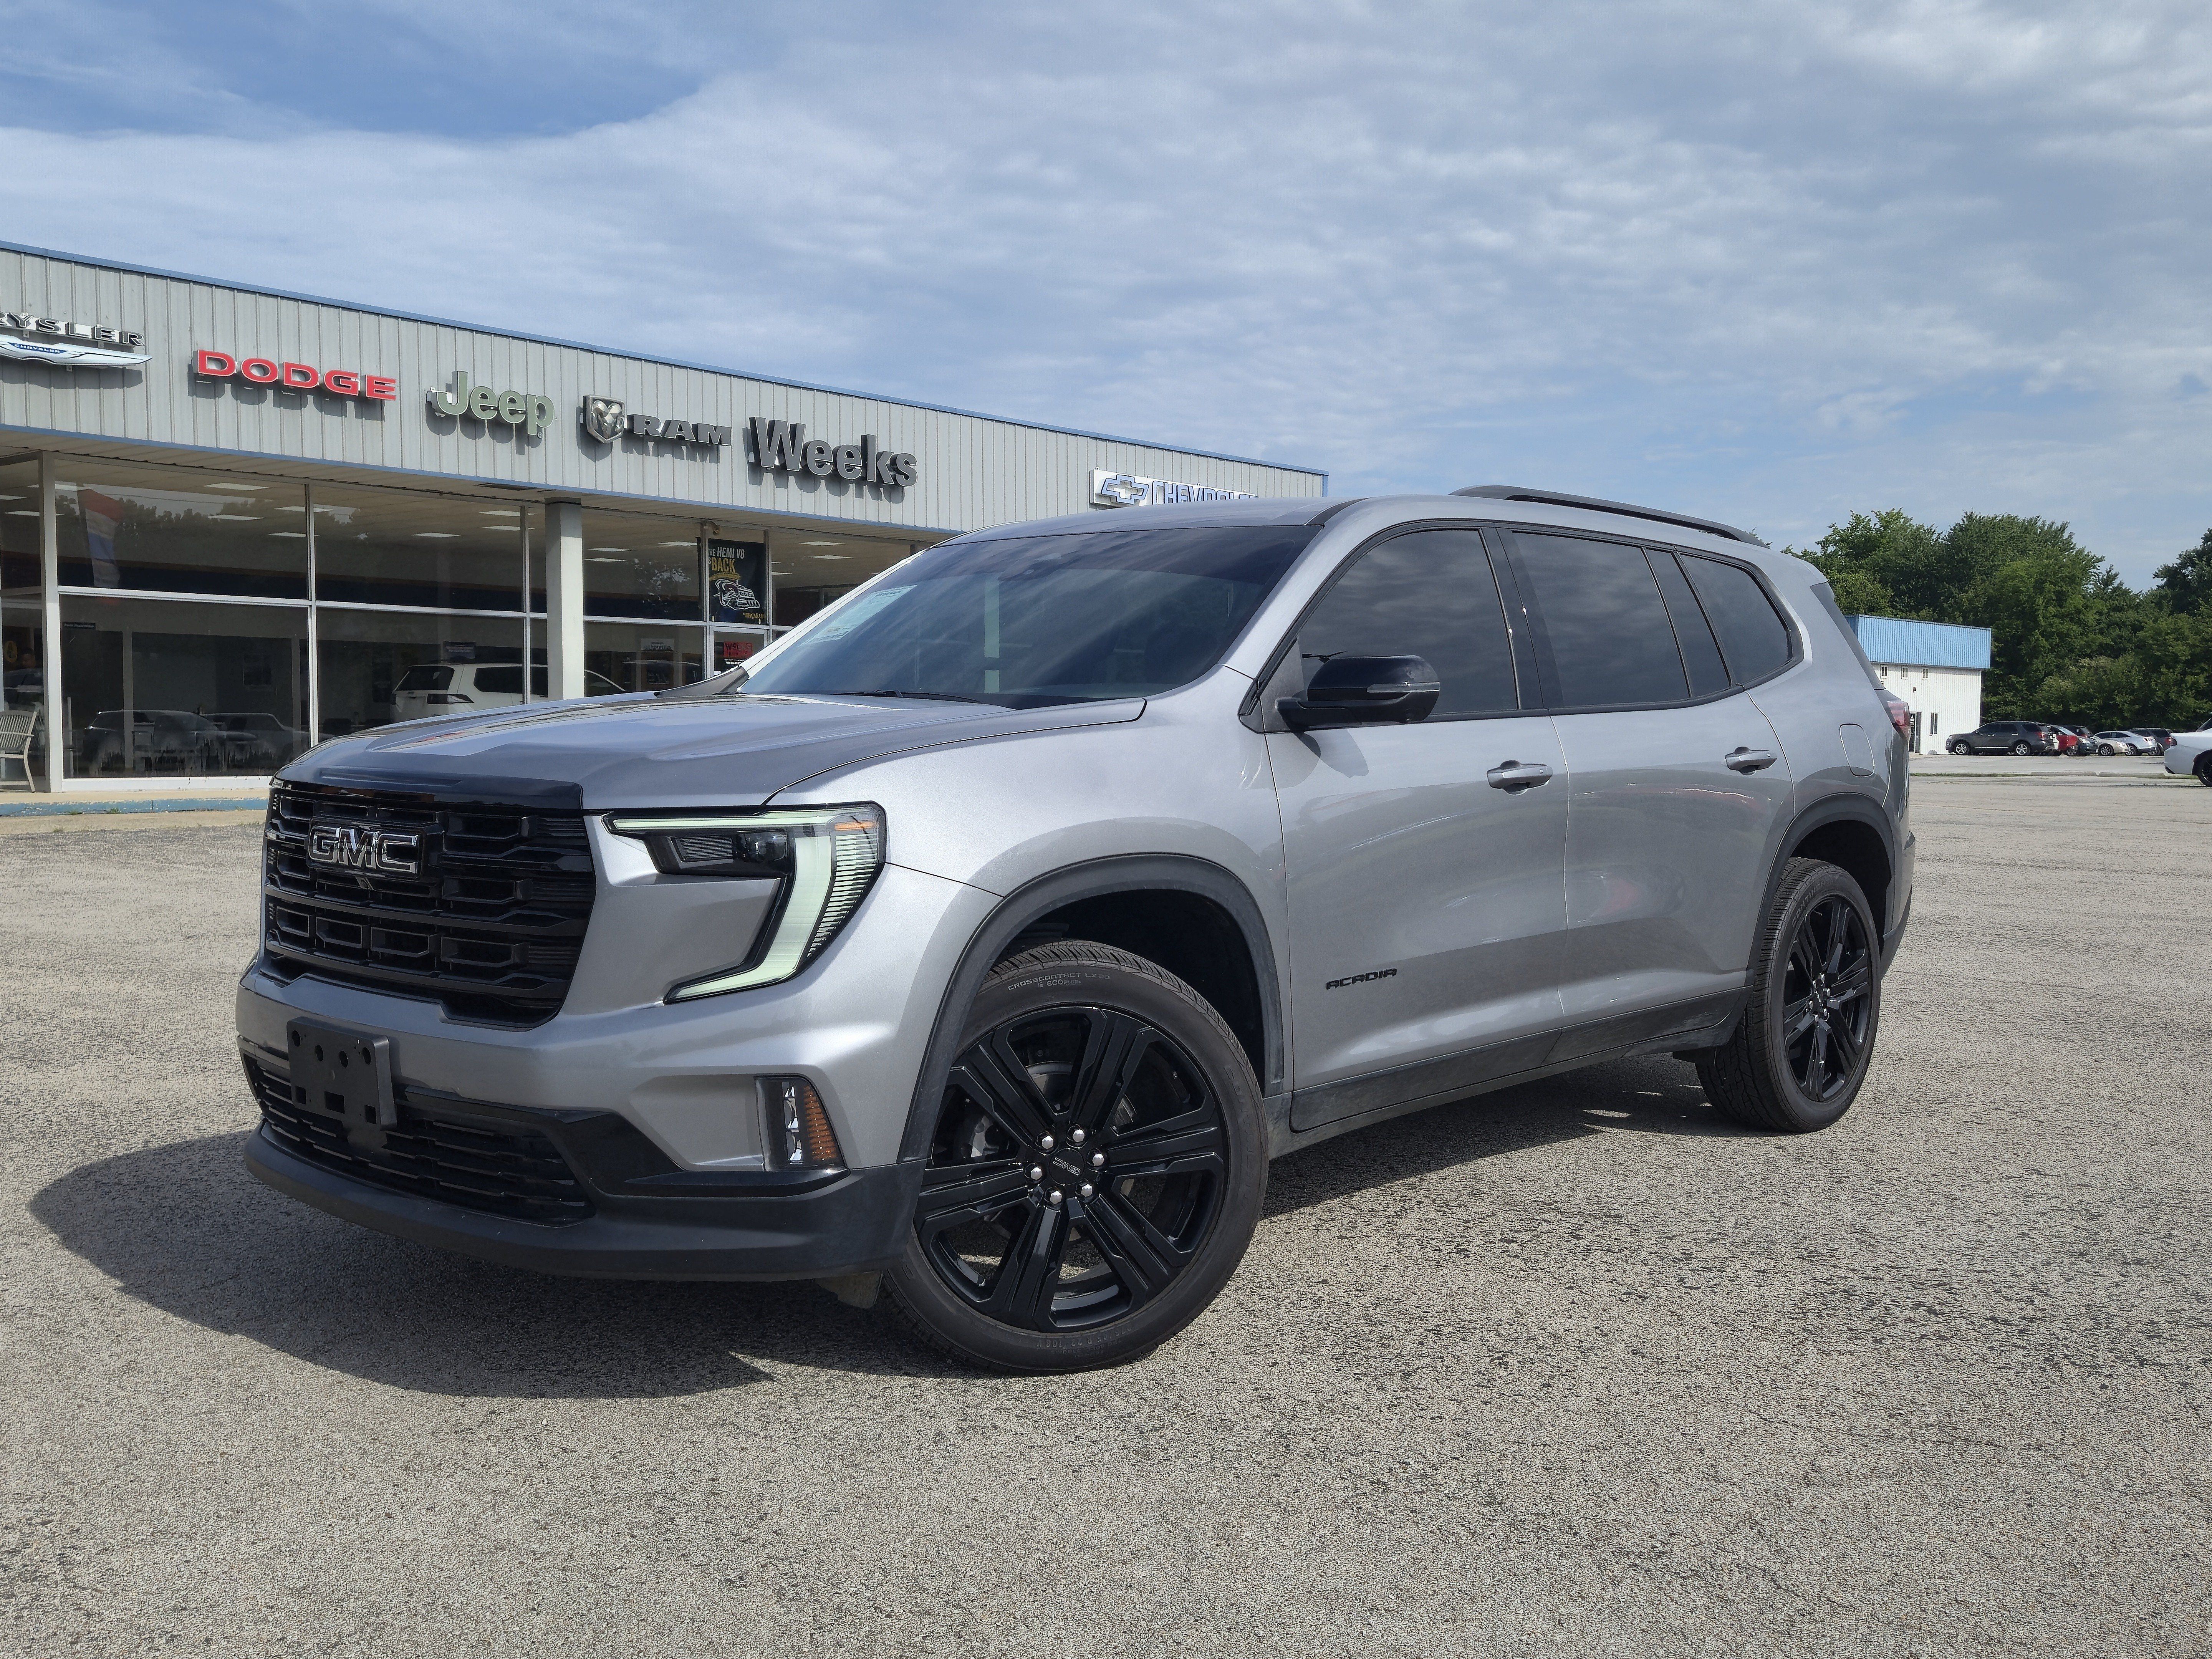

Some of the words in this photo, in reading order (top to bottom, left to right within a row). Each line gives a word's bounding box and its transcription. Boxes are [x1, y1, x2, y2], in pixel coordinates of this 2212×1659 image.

[14, 344, 60, 353] CHRYSLER
[197, 349, 397, 401] DODGE
[433, 370, 556, 436] Jeep
[628, 414, 732, 446] RAM
[750, 416, 919, 488] Weeks
[717, 547, 734, 558] HEMI
[737, 548, 745, 559] V8
[711, 557, 735, 573] BACK
[308, 825, 419, 874] GMC
[1008, 972, 1081, 990] CROSSCONTACT
[1326, 968, 1397, 990] ACADIA
[1053, 1157, 1081, 1176] GMC
